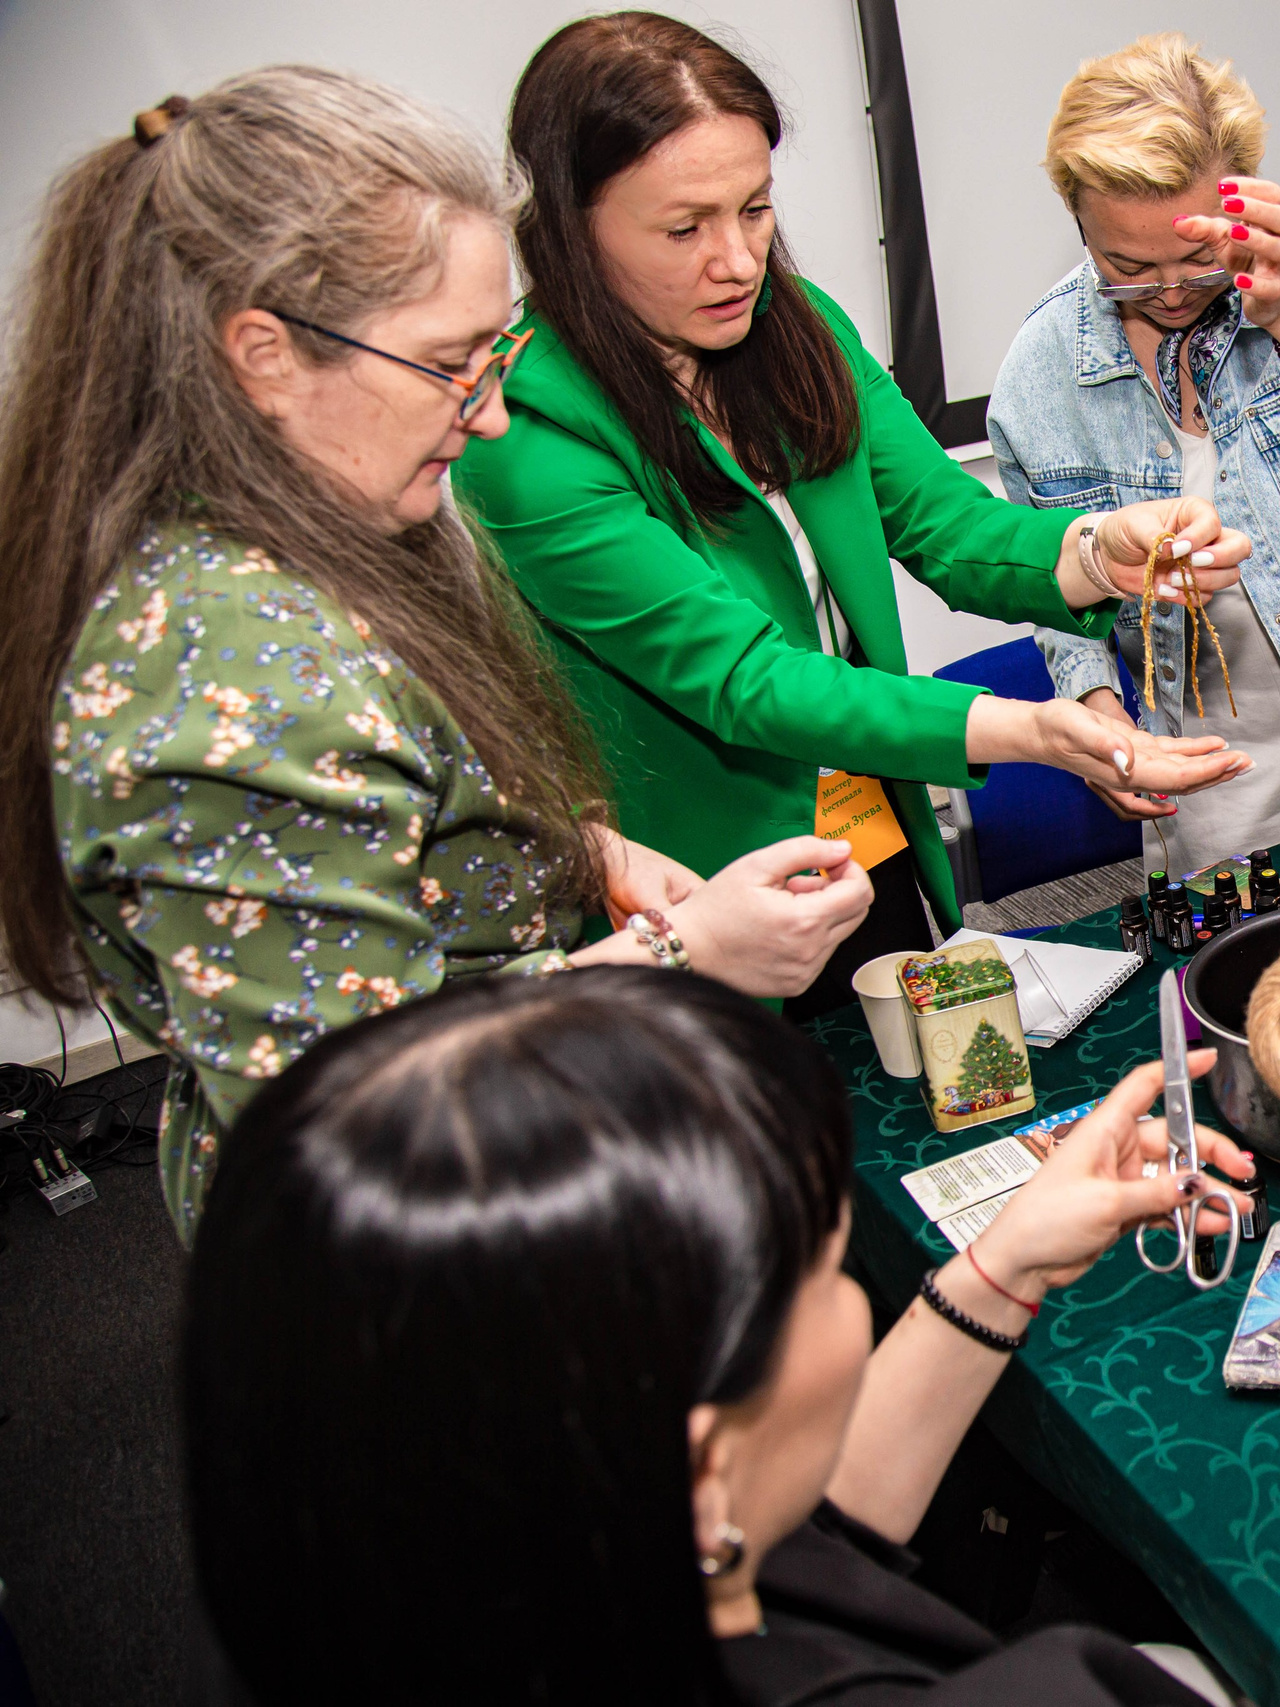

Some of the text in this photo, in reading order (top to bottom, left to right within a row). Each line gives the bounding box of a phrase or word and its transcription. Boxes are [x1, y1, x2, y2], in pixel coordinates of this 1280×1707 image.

[822, 778, 852, 799] Мастер
[822, 788, 862, 817] фестиваля
[820, 804, 882, 840] Юлия Зуева
